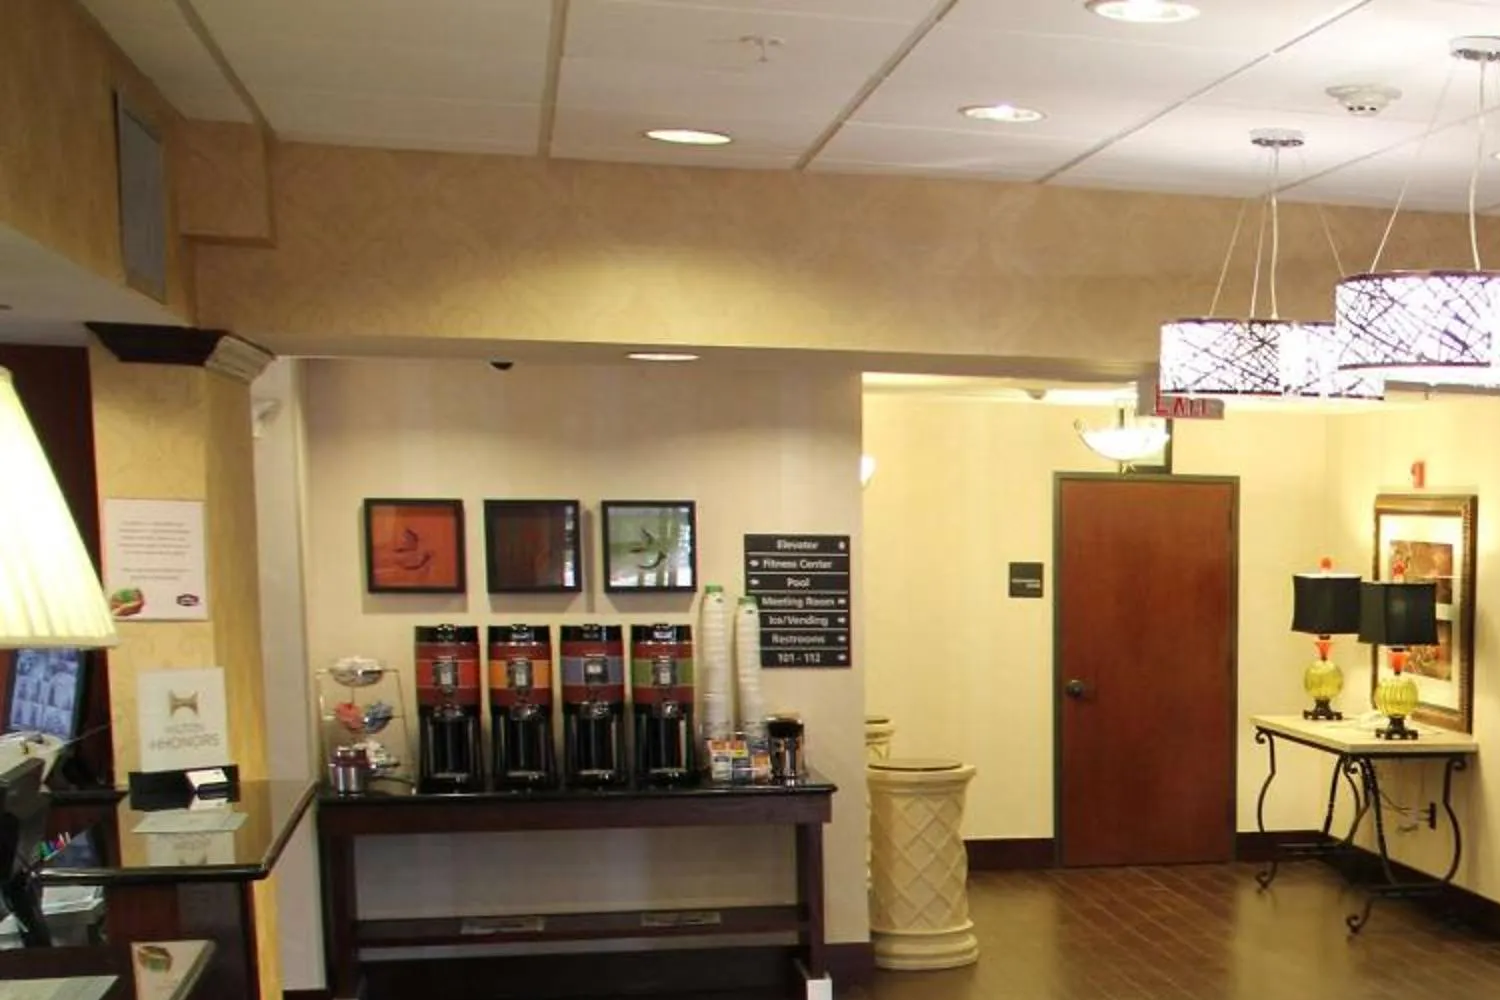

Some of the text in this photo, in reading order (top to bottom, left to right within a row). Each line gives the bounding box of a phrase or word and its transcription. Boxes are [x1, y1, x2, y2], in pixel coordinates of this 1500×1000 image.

[763, 559, 833, 569] Fitness Center
[786, 577, 811, 588] Pool
[761, 597, 803, 608] Meeting
[771, 633, 826, 644] Restrooms
